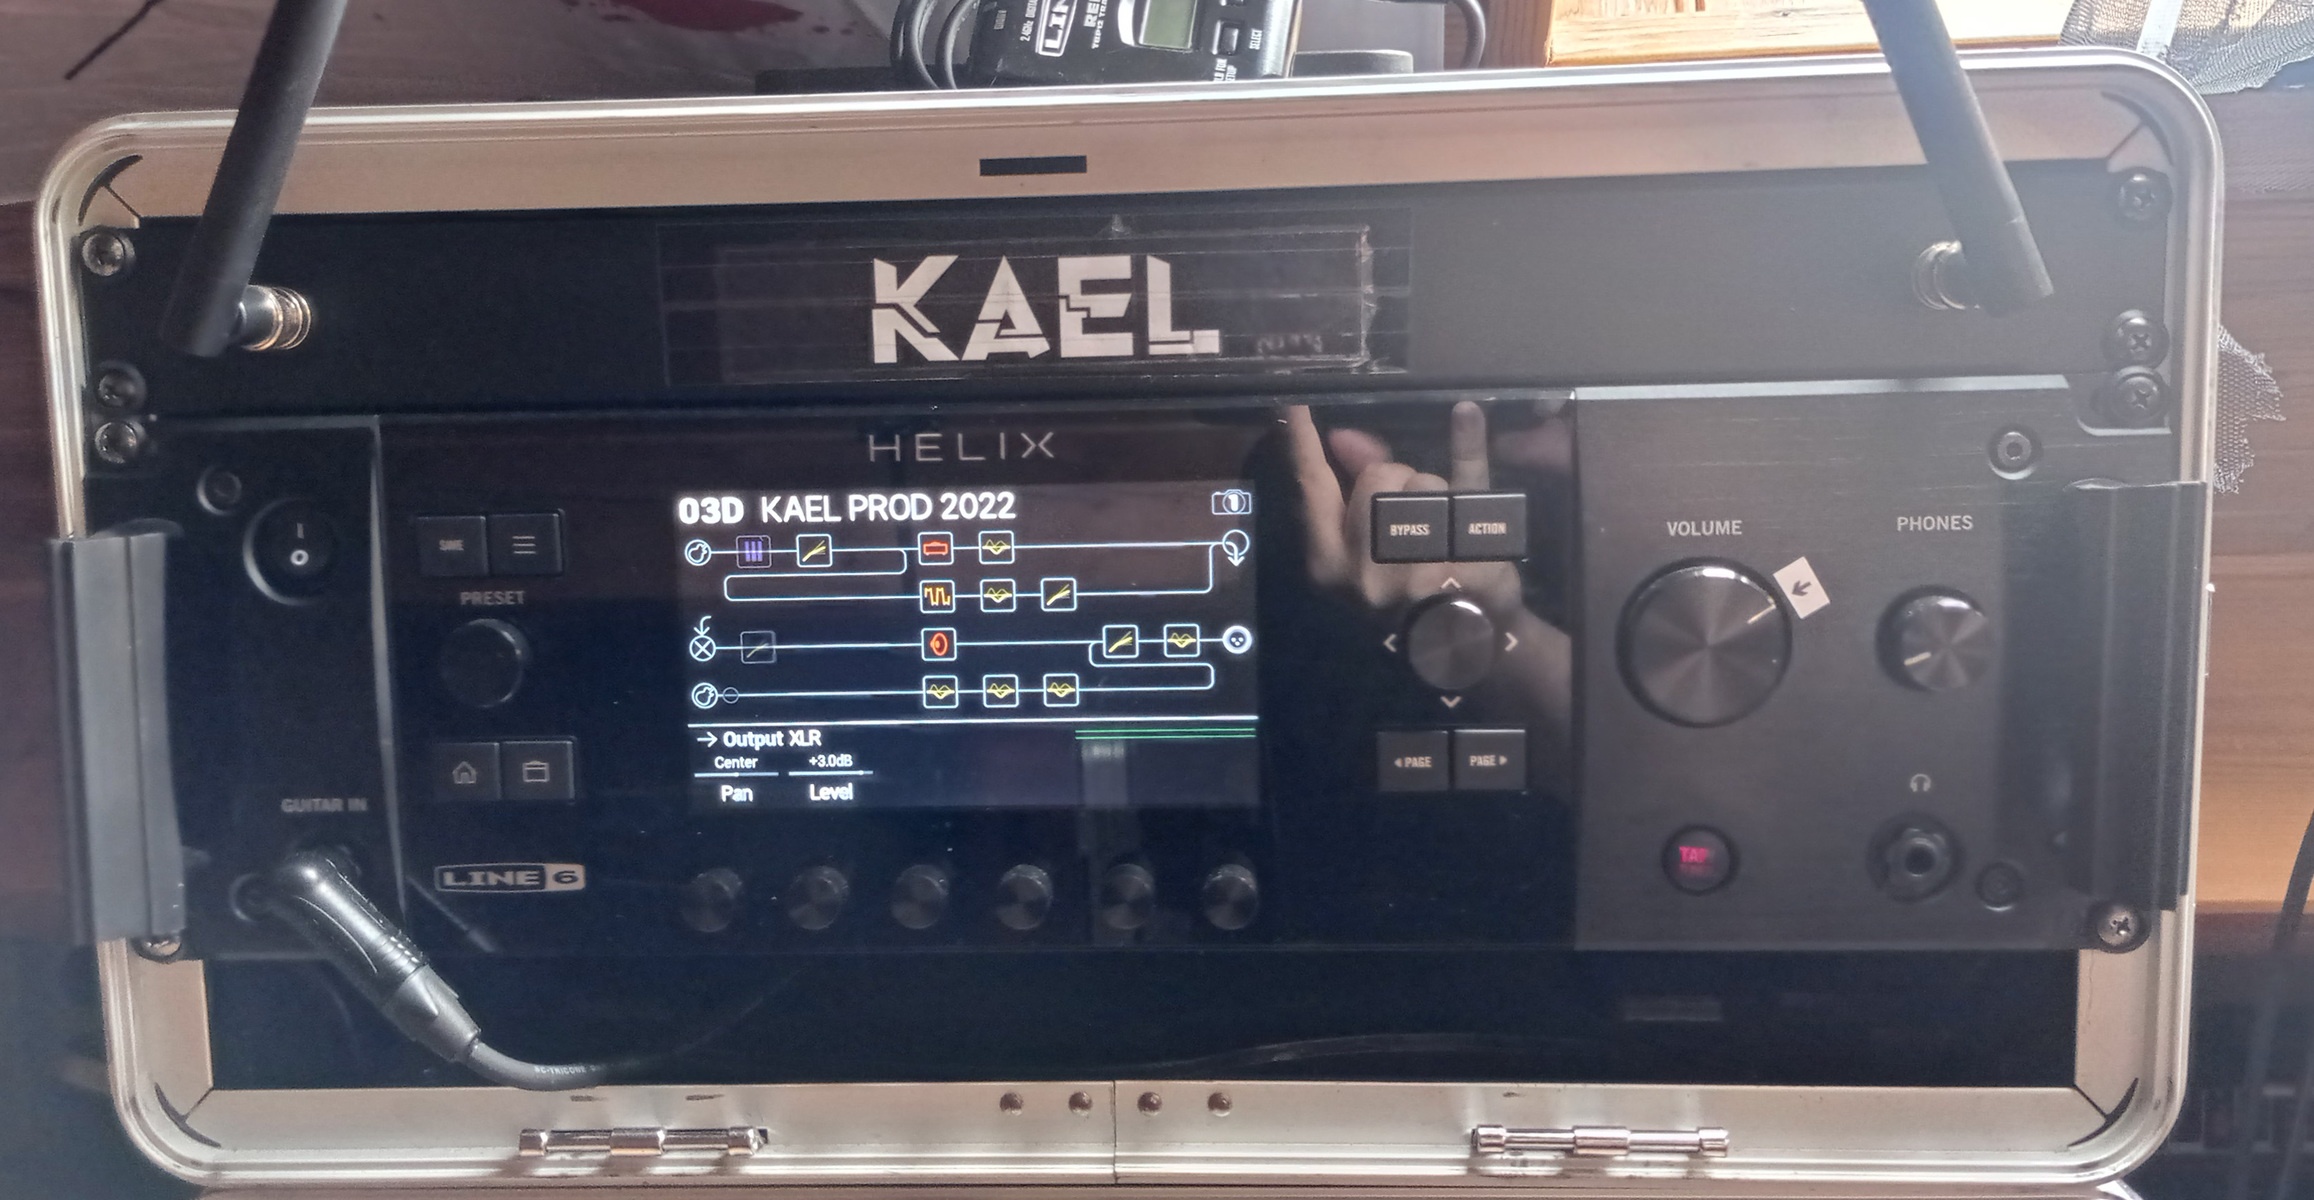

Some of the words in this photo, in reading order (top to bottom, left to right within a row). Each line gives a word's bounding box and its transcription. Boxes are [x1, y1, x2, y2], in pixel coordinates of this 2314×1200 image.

[872, 254, 1221, 363] KAEL
[868, 431, 1055, 462] HELIX
[678, 496, 745, 525] 03D
[761, 495, 842, 524] KAEL
[848, 493, 933, 522] PROD
[940, 491, 1017, 520] 2022
[1390, 523, 1430, 536] BYPASS
[1468, 522, 1507, 535] ACTION
[1666, 519, 1743, 537] VOLUME
[1896, 514, 1974, 533] PHONES
[460, 590, 526, 606] PRESET
[722, 731, 785, 751] Output
[789, 729, 822, 748] XLR
[714, 755, 759, 770] Center
[808, 753, 854, 768] +3.0dB
[1404, 756, 1432, 769] PAGE
[1469, 755, 1496, 767] PAGE
[720, 784, 754, 803] Pan
[809, 783, 854, 802] Level
[281, 798, 344, 813] GUITAR
[347, 798, 368, 812] IN
[442, 870, 541, 888] LINE
[551, 870, 580, 886] 6
